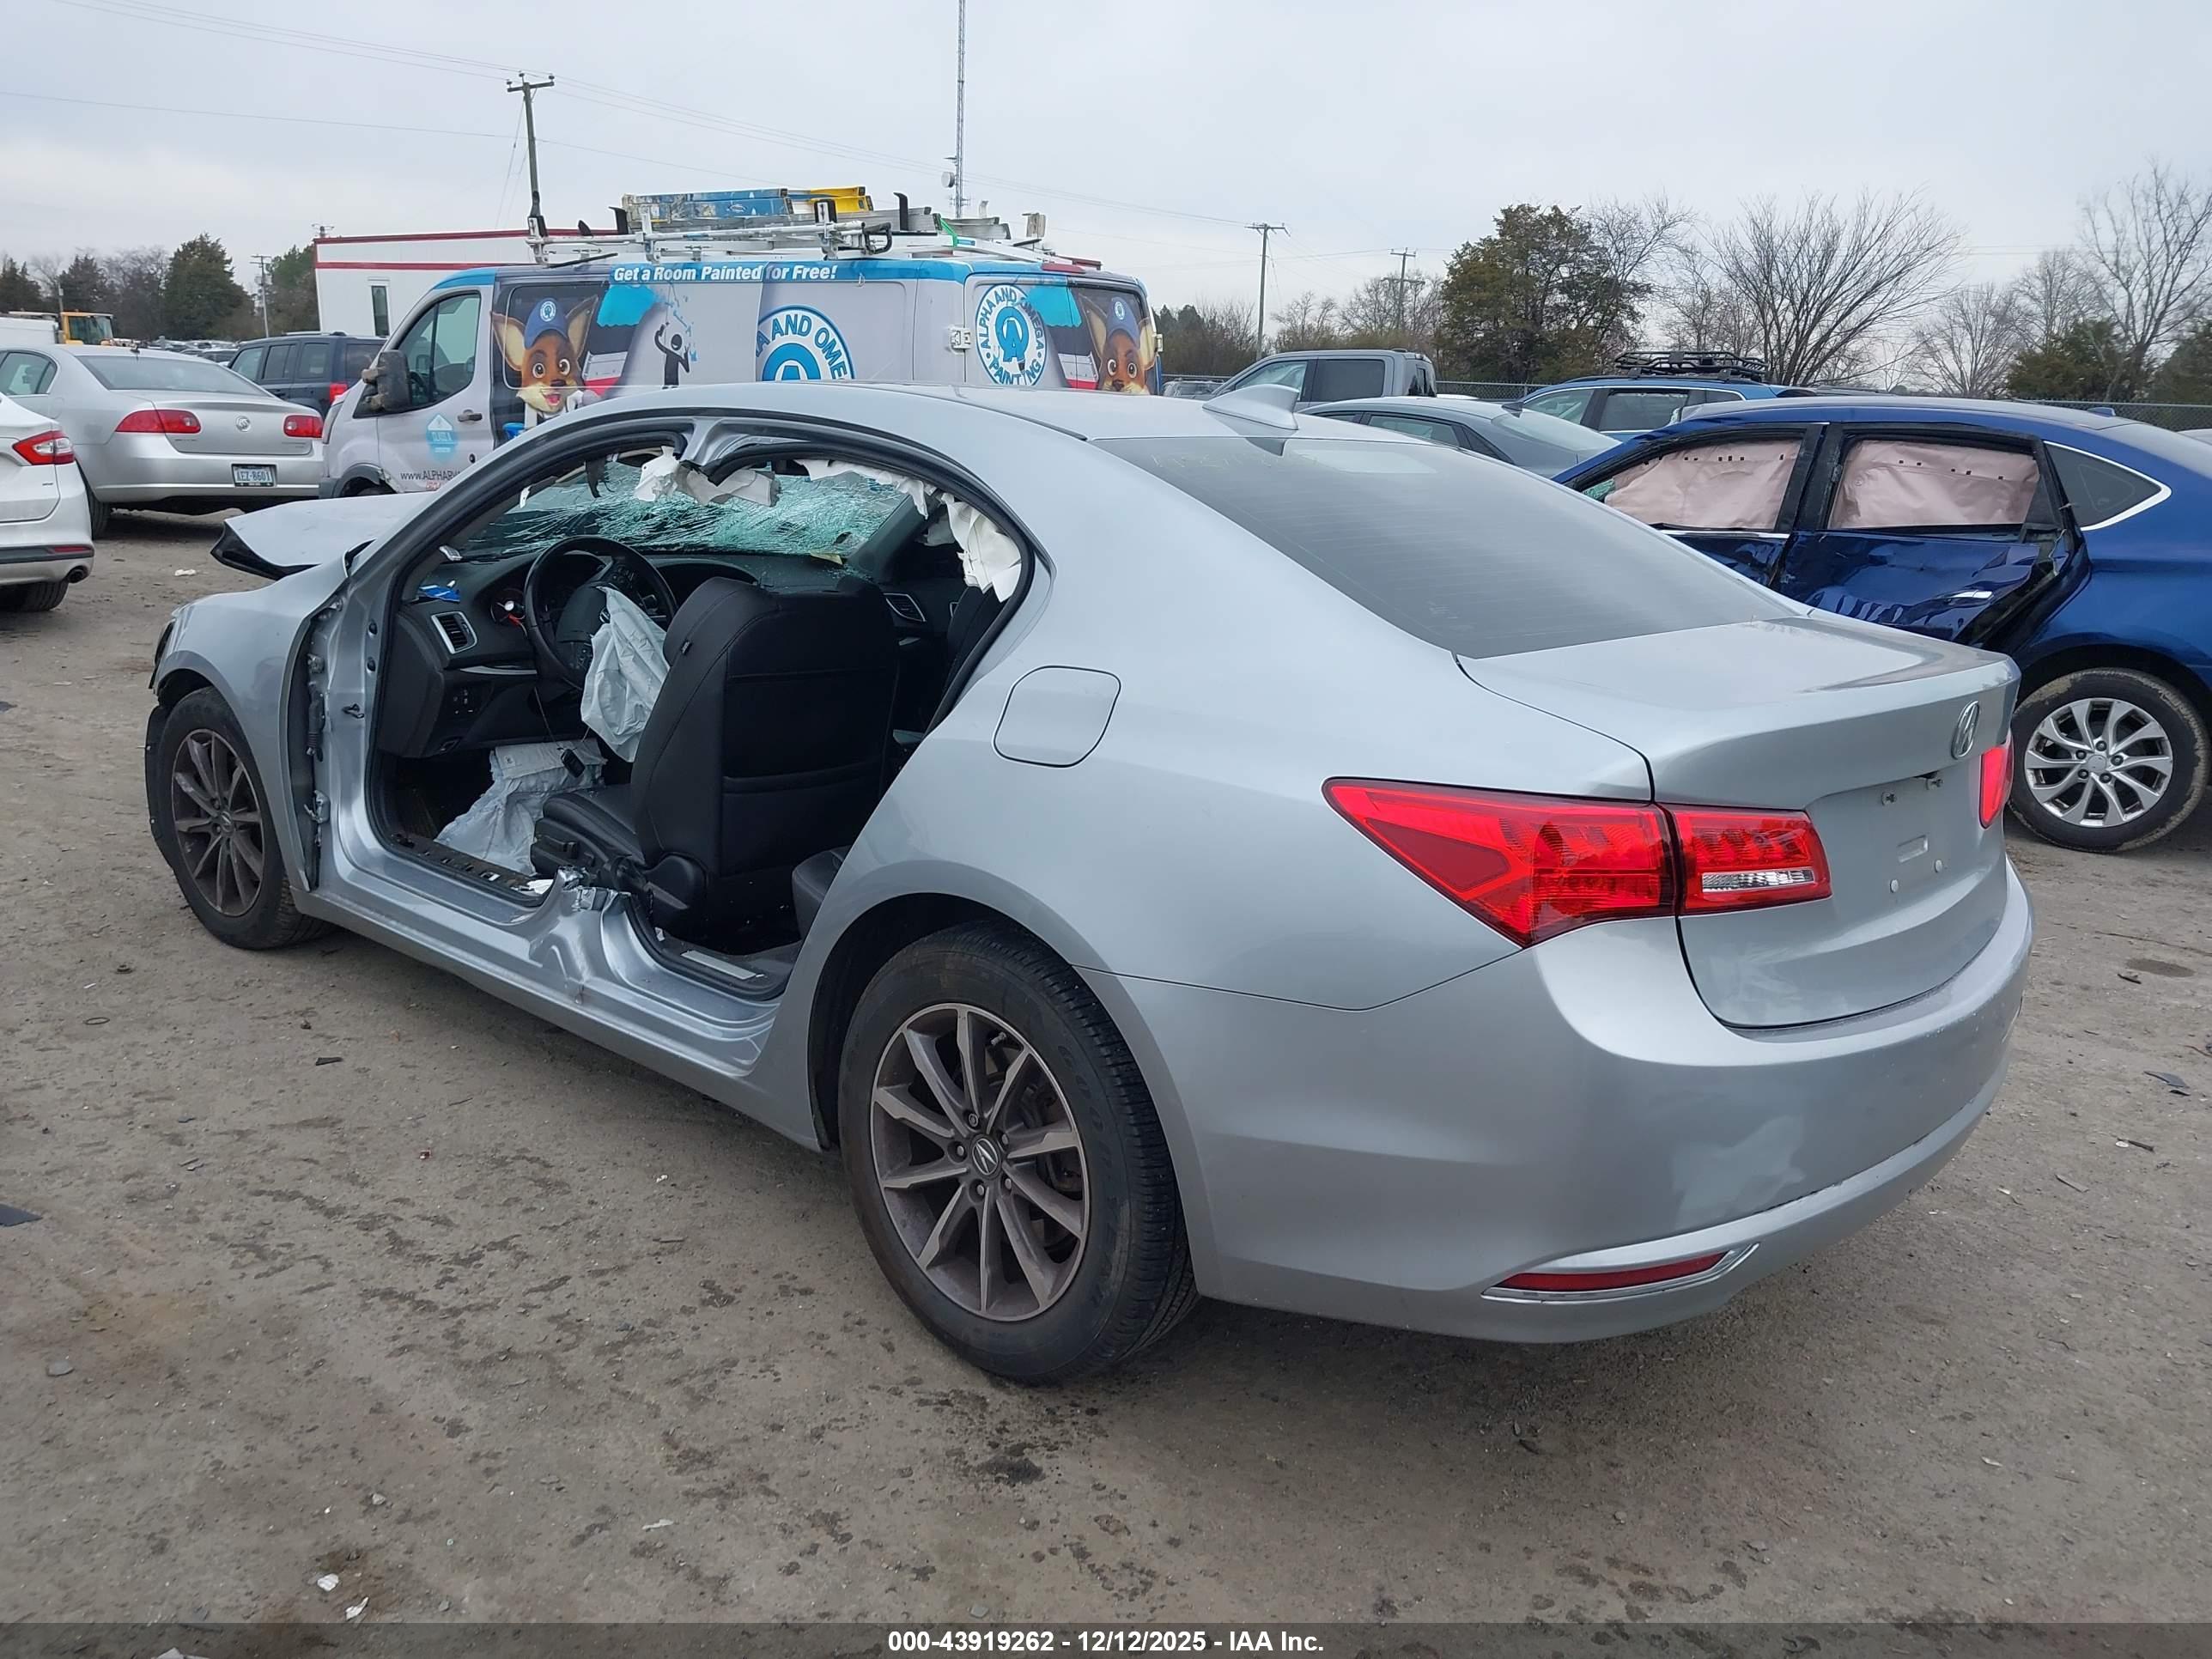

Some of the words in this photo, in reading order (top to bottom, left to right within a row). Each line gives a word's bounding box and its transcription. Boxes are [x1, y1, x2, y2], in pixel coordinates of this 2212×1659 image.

[614, 267, 639, 282] Get
[641, 269, 651, 281] a
[653, 266, 696, 281] Room
[701, 265, 764, 281] Painted
[765, 265, 790, 281] for
[792, 264, 838, 280] Free!
[772, 313, 812, 341] AND
[814, 327, 848, 380] OME
[979, 299, 996, 349] ALPHA
[994, 287, 1017, 305] AND
[1018, 296, 1044, 350] OMEGA
